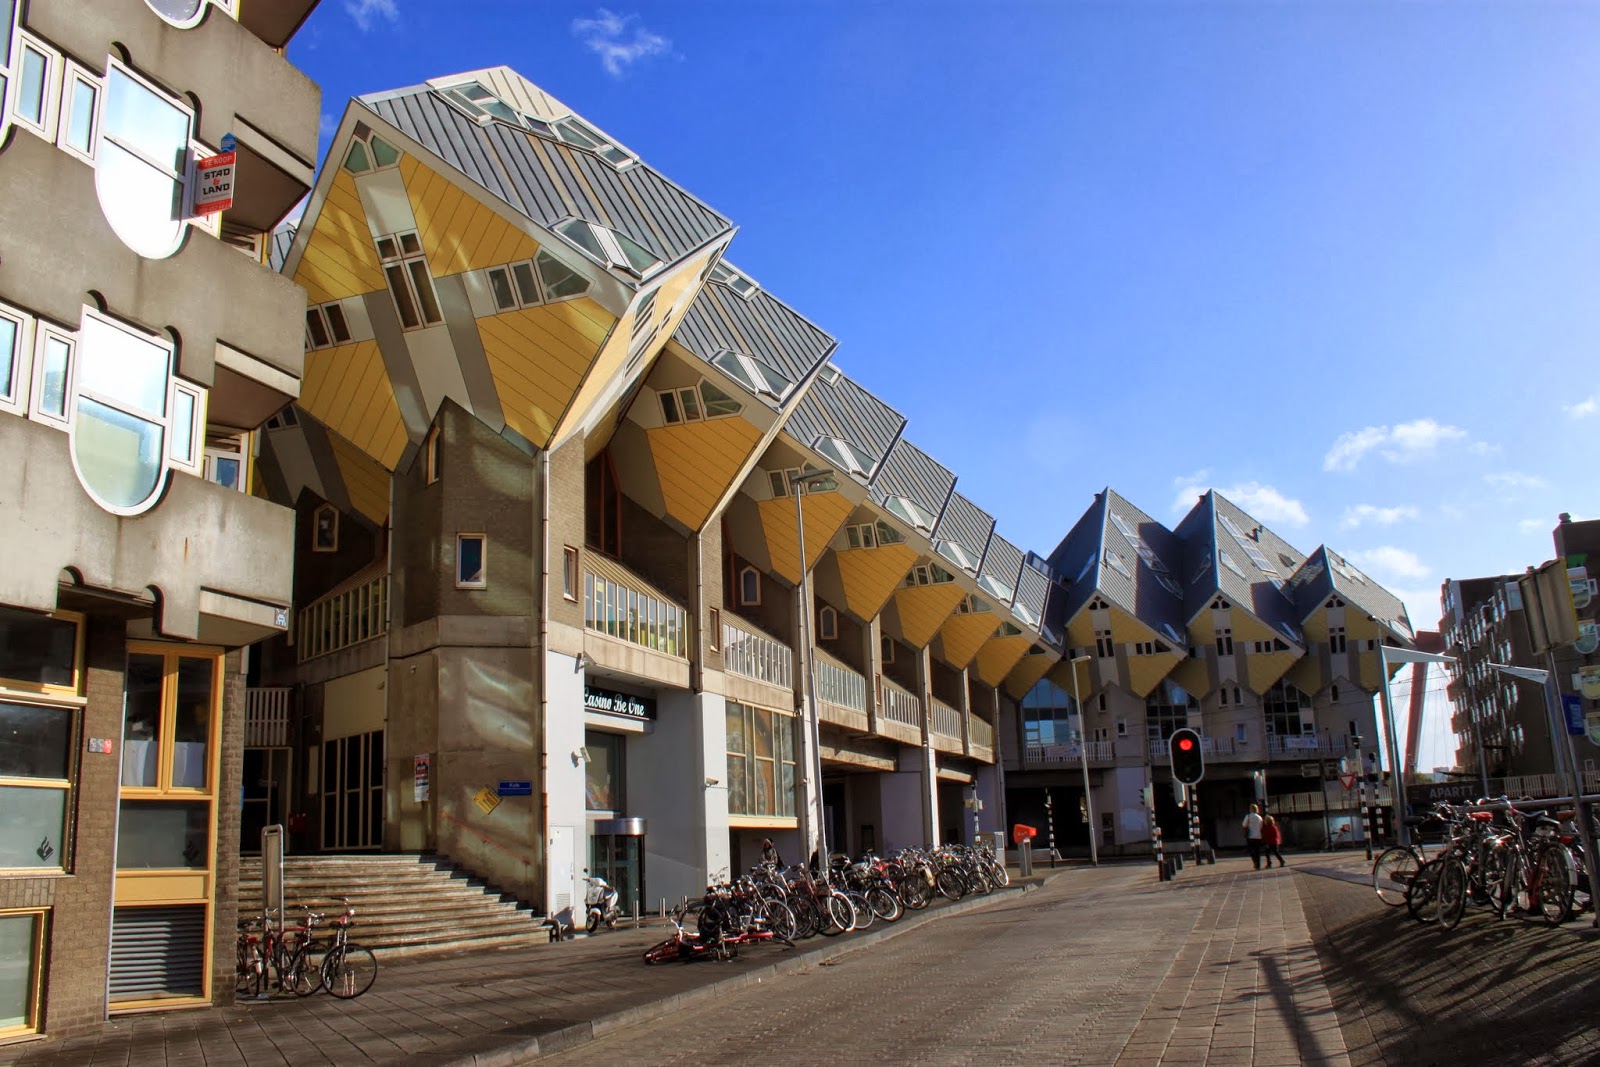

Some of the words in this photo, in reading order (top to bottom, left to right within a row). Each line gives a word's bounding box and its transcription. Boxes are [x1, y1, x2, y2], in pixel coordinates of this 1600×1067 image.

[213, 156, 232, 165] KOOP
[204, 168, 231, 180] STAD
[213, 178, 220, 186] &
[203, 183, 230, 195] LAND
[584, 687, 612, 710] Casino
